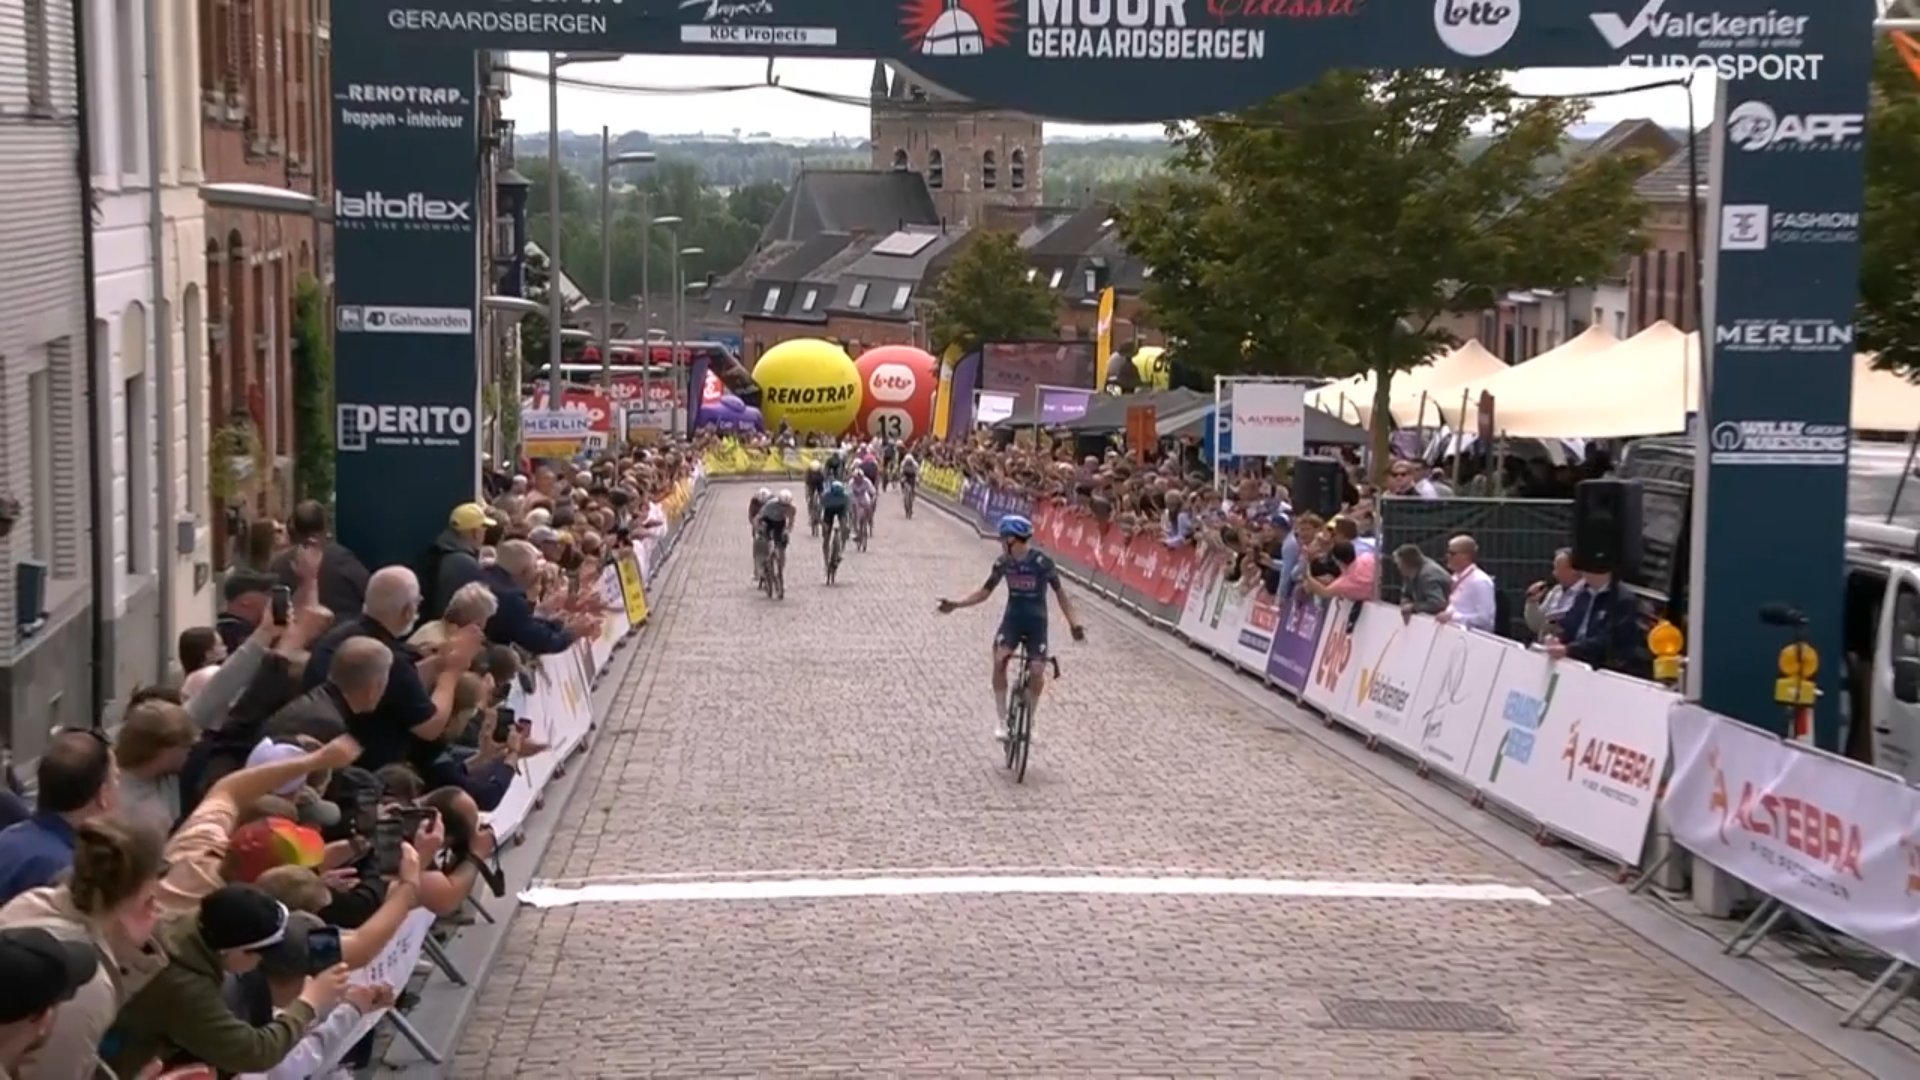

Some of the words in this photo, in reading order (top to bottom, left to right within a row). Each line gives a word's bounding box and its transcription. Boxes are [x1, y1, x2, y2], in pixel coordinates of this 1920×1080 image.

[388, 9, 607, 34] GERAARDSBERGEN
[1647, 9, 1809, 38] Valckenier
[710, 26, 739, 40] KDC
[745, 28, 808, 43] Projects
[1027, 27, 1265, 59] GERAARDSBERGEN
[348, 84, 461, 105] RENOTRAP
[406, 107, 464, 128] interieur
[335, 188, 471, 221] lattoflex
[1772, 211, 1859, 228] FASHION
[389, 313, 468, 328] Galmaarden
[1716, 325, 1853, 344] MERLIN
[873, 373, 912, 389] lotto
[767, 384, 854, 404] RENOTRAP
[357, 405, 472, 435] DERITO
[524, 417, 588, 431] MERLIN
[877, 414, 902, 442] 13
[1579, 737, 1656, 791] ALTEBRA
[1735, 781, 1864, 882] ALTEBRA
